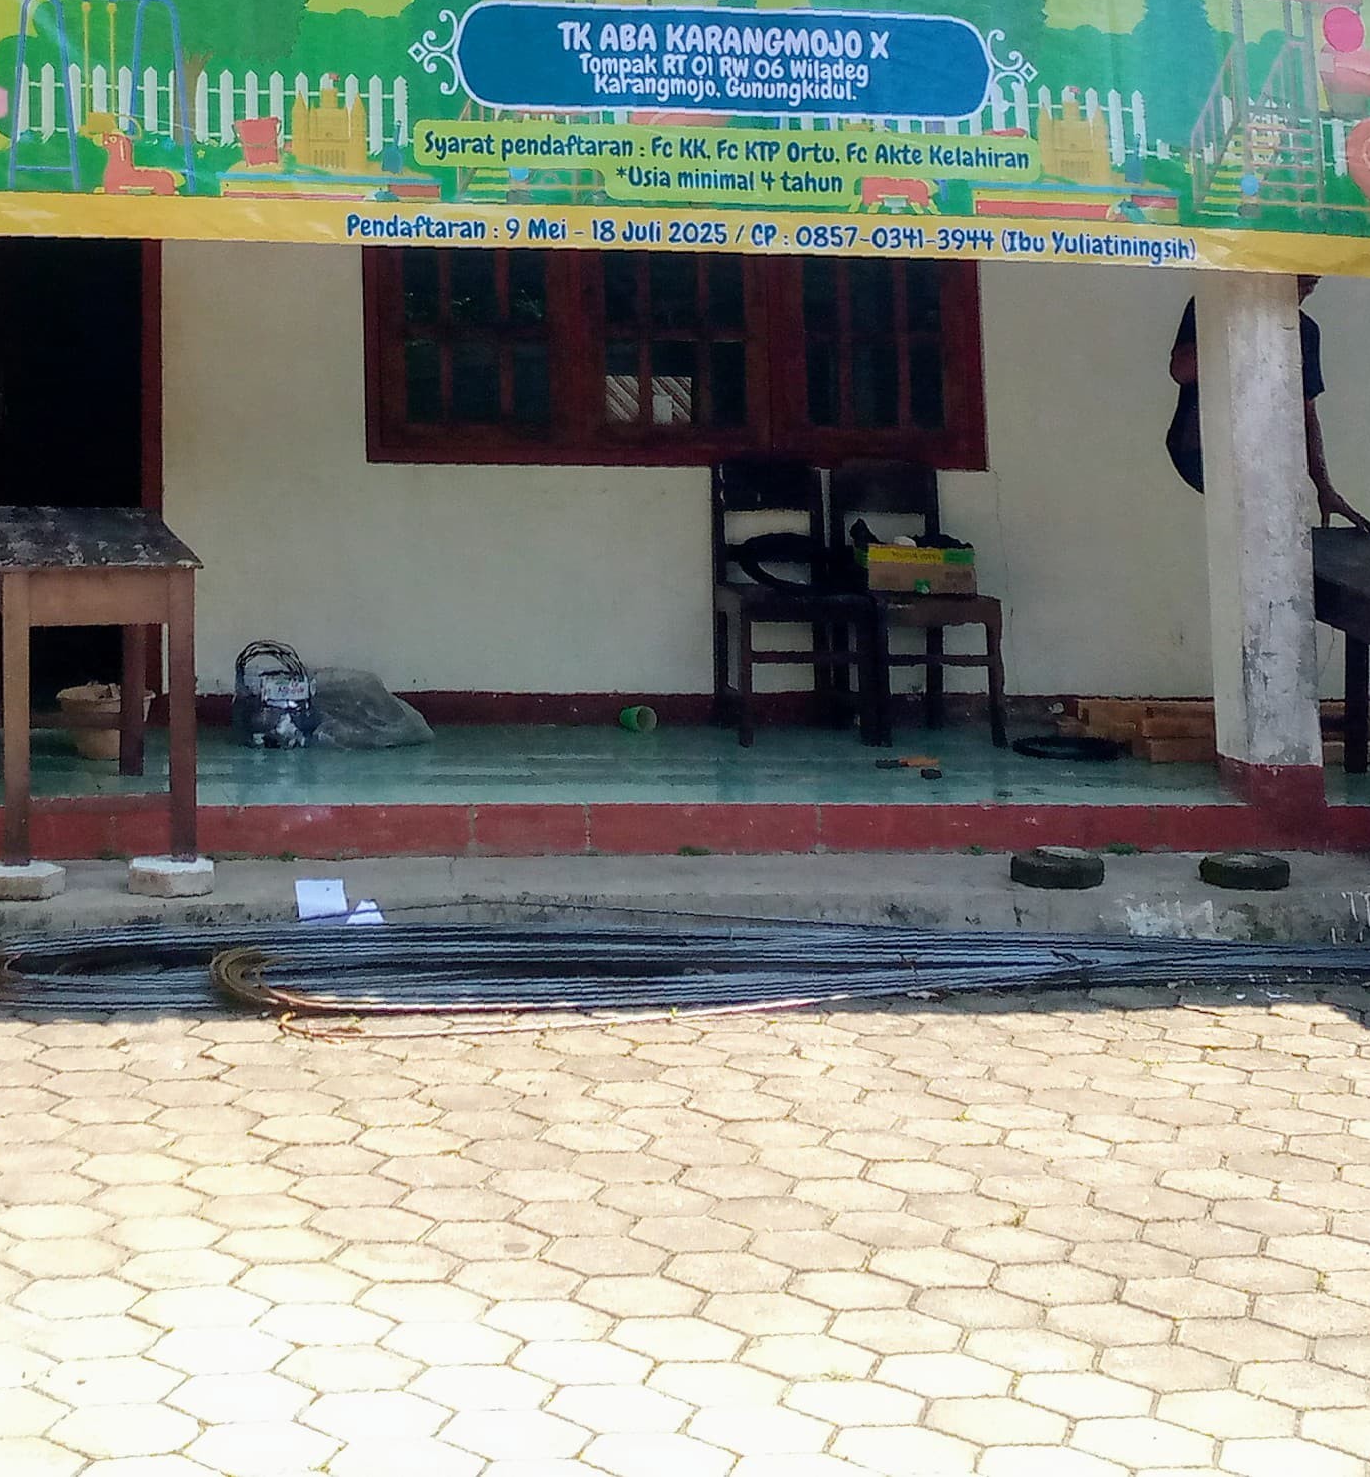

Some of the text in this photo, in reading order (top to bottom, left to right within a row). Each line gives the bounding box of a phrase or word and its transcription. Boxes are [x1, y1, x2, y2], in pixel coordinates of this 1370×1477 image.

[558, 22, 889, 59] TK ABA KARANGMOJO X
[579, 53, 869, 87] Tompak RT 01 RW 06 Wiladeg
[725, 79, 857, 106] Gunungkidul.
[425, 132, 495, 159] Syarat
[502, 136, 632, 160] pendaftaran
[651, 140, 673, 159] Fc
[717, 141, 738, 160] Fc
[745, 141, 781, 162] KTP
[846, 143, 867, 163] Fc
[875, 143, 924, 165] Akte
[930, 145, 1029, 169] Kelahiran
[678, 171, 755, 191] minimal
[762, 172, 775, 190] 4
[781, 172, 842, 193] tahun
[346, 214, 486, 239] Pendaftaran
[505, 218, 519, 239] 9
[528, 219, 567, 240] Mei
[592, 220, 616, 242] 18
[622, 220, 661, 243] Juli
[669, 222, 728, 244] 2025
[735, 224, 744, 244] /
[751, 225, 777, 245] CP
[796, 226, 995, 251] 0857-0341-3944
[1002, 231, 1045, 254] (Ibu
[1053, 231, 1197, 265] Yuliatiningsih)
